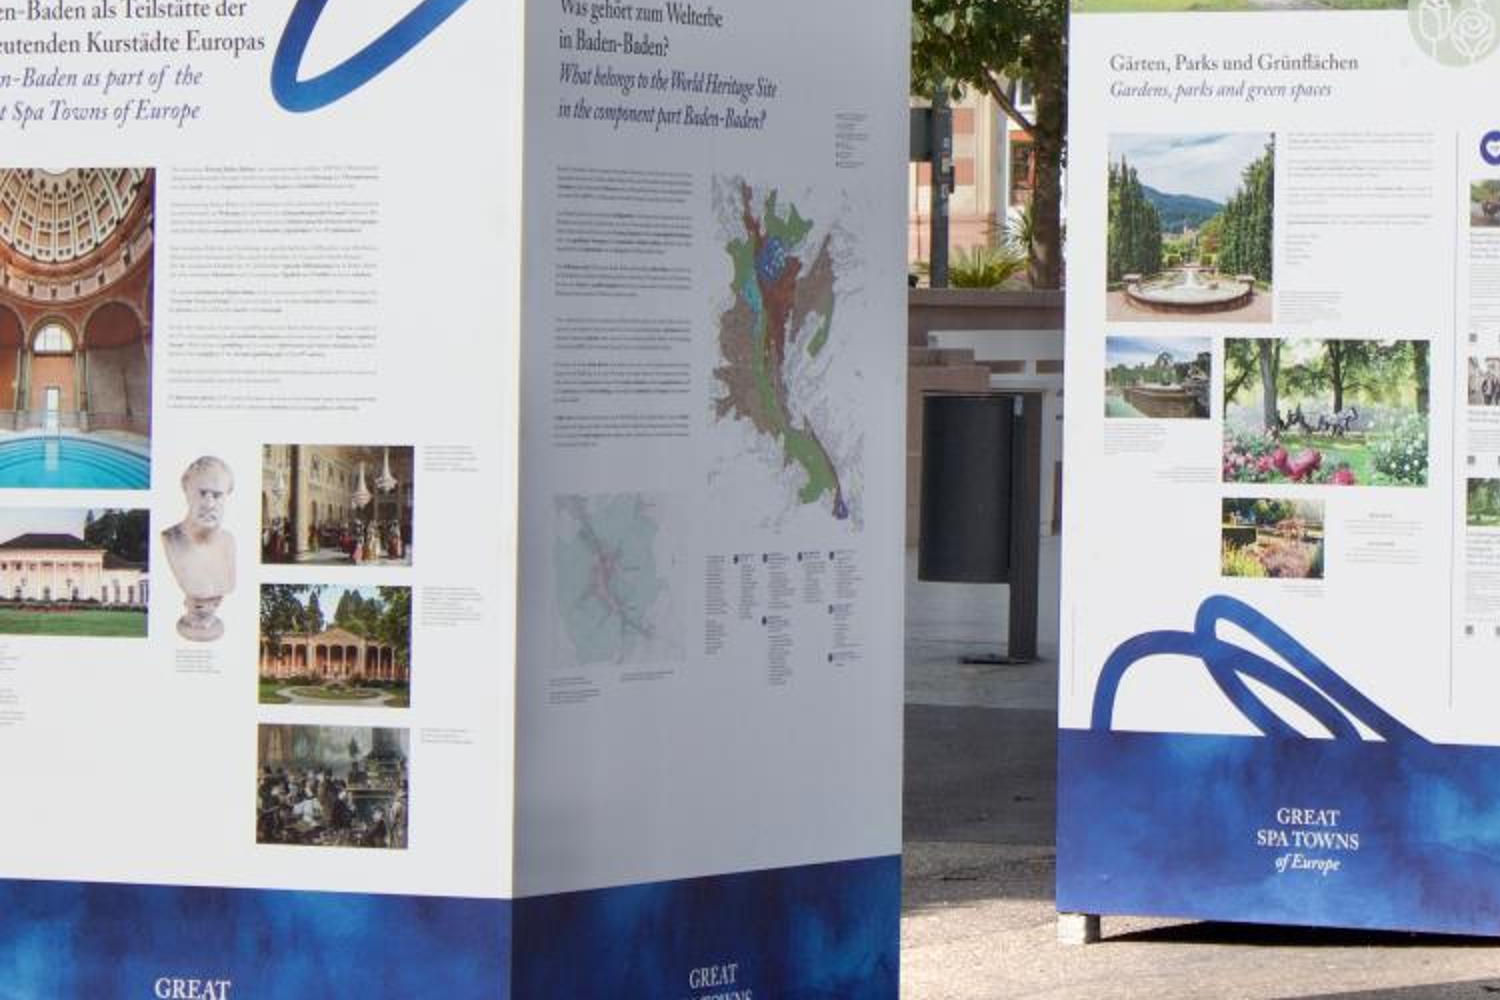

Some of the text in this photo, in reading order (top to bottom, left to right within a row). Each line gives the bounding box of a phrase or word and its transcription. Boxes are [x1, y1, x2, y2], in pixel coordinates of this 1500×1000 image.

[635, 6, 663, 22] zum
[666, 1, 724, 28] Welterbe
[87, 30, 180, 53] Kurstädte
[186, 30, 266, 58] Europas
[559, 28, 669, 57] in Baden-Baden?
[1109, 53, 1359, 73] Gärten, Parks und Grünflächen
[82, 73, 100, 86] as
[103, 68, 143, 94] part
[148, 64, 171, 94] of
[175, 63, 203, 85] the
[559, 62, 778, 104] What belongs to the World Heritage Site
[1109, 80, 1333, 103] Gardens, parks and green spaces
[12, 101, 44, 129] Spa
[50, 99, 108, 121] Towns
[113, 99, 135, 129] of
[135, 99, 202, 129] Europe
[558, 97, 767, 132] in the component part Baden-Baden?
[1276, 807, 1341, 827] GREAT
[1256, 828, 1360, 851] SPA TOWNS
[1274, 853, 1341, 877] of Europe
[154, 977, 232, 1000] GREAT
[688, 963, 738, 989] GREAT
